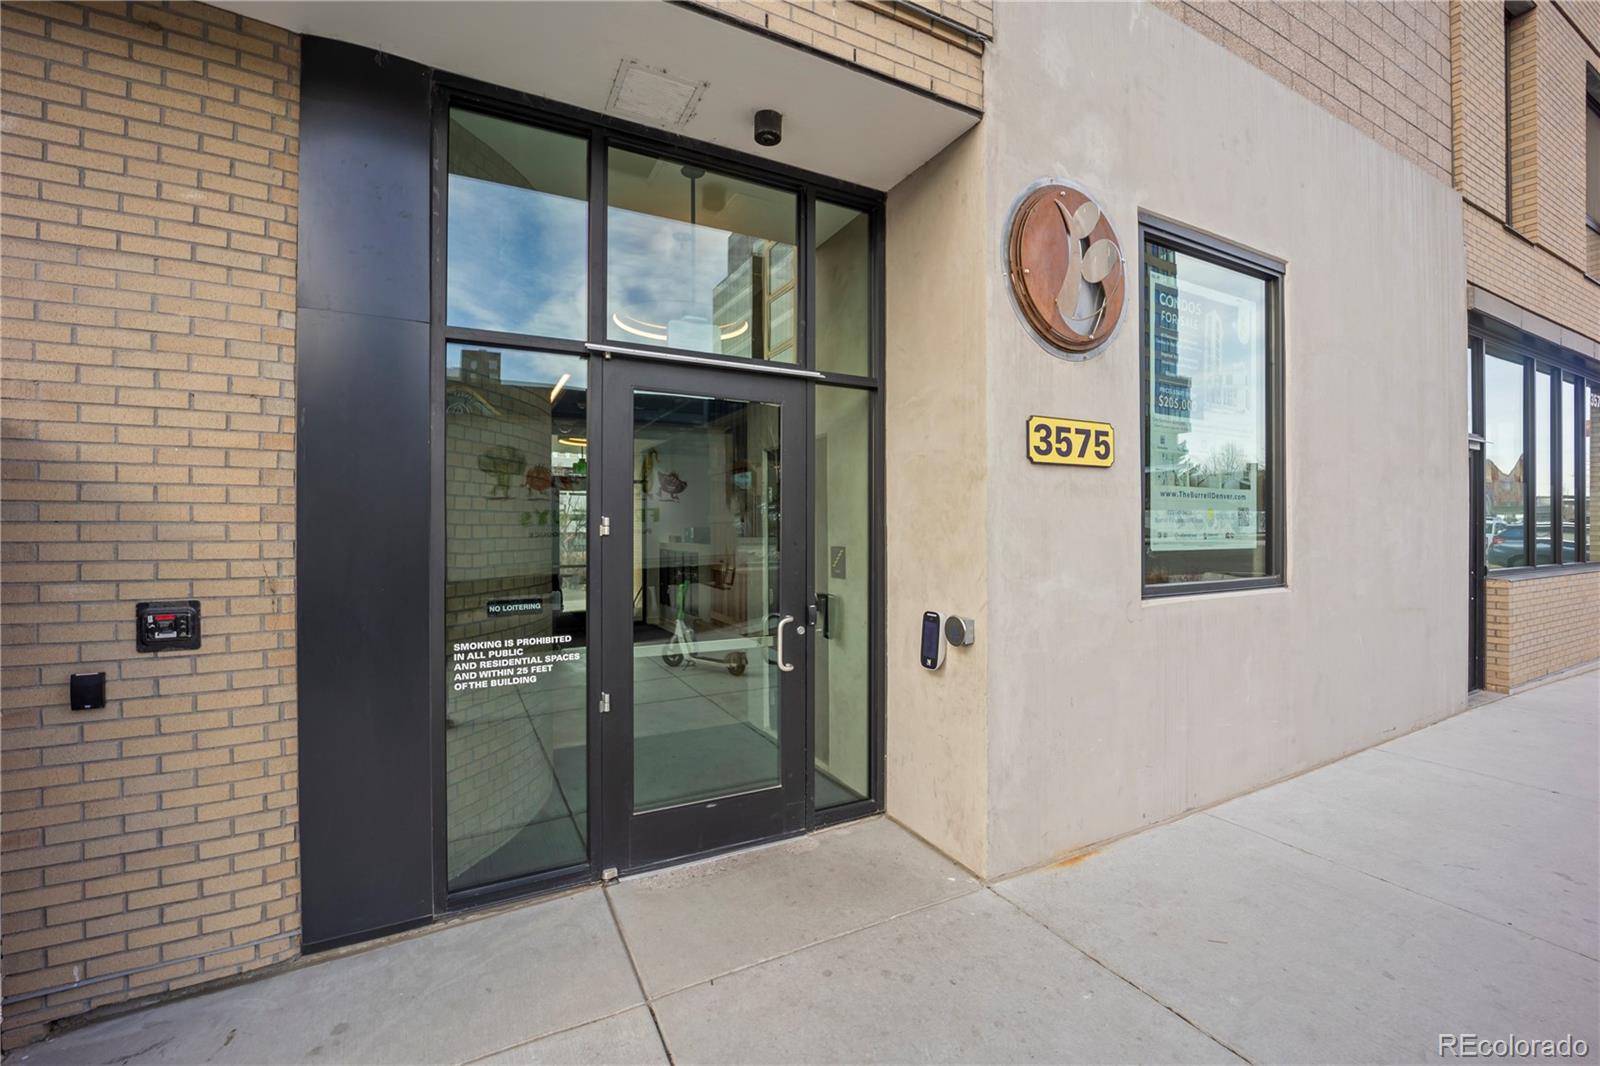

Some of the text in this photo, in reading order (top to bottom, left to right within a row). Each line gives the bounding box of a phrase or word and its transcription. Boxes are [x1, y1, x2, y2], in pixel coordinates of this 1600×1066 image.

[1159, 292, 1202, 315] CONDOS
[1160, 310, 1178, 324] FOR
[1033, 423, 1111, 460] 3575
[489, 602, 542, 613] NO LOITERING
[453, 635, 572, 652] SMOKING IS PROHIBITED
[453, 648, 524, 661] IN ALL PUBLIC
[453, 652, 581, 671] AND RESIDENTIAL SPACES
[453, 664, 553, 681] AND WITHIN 25 FEET
[454, 675, 537, 691] OF THE BUILDING
